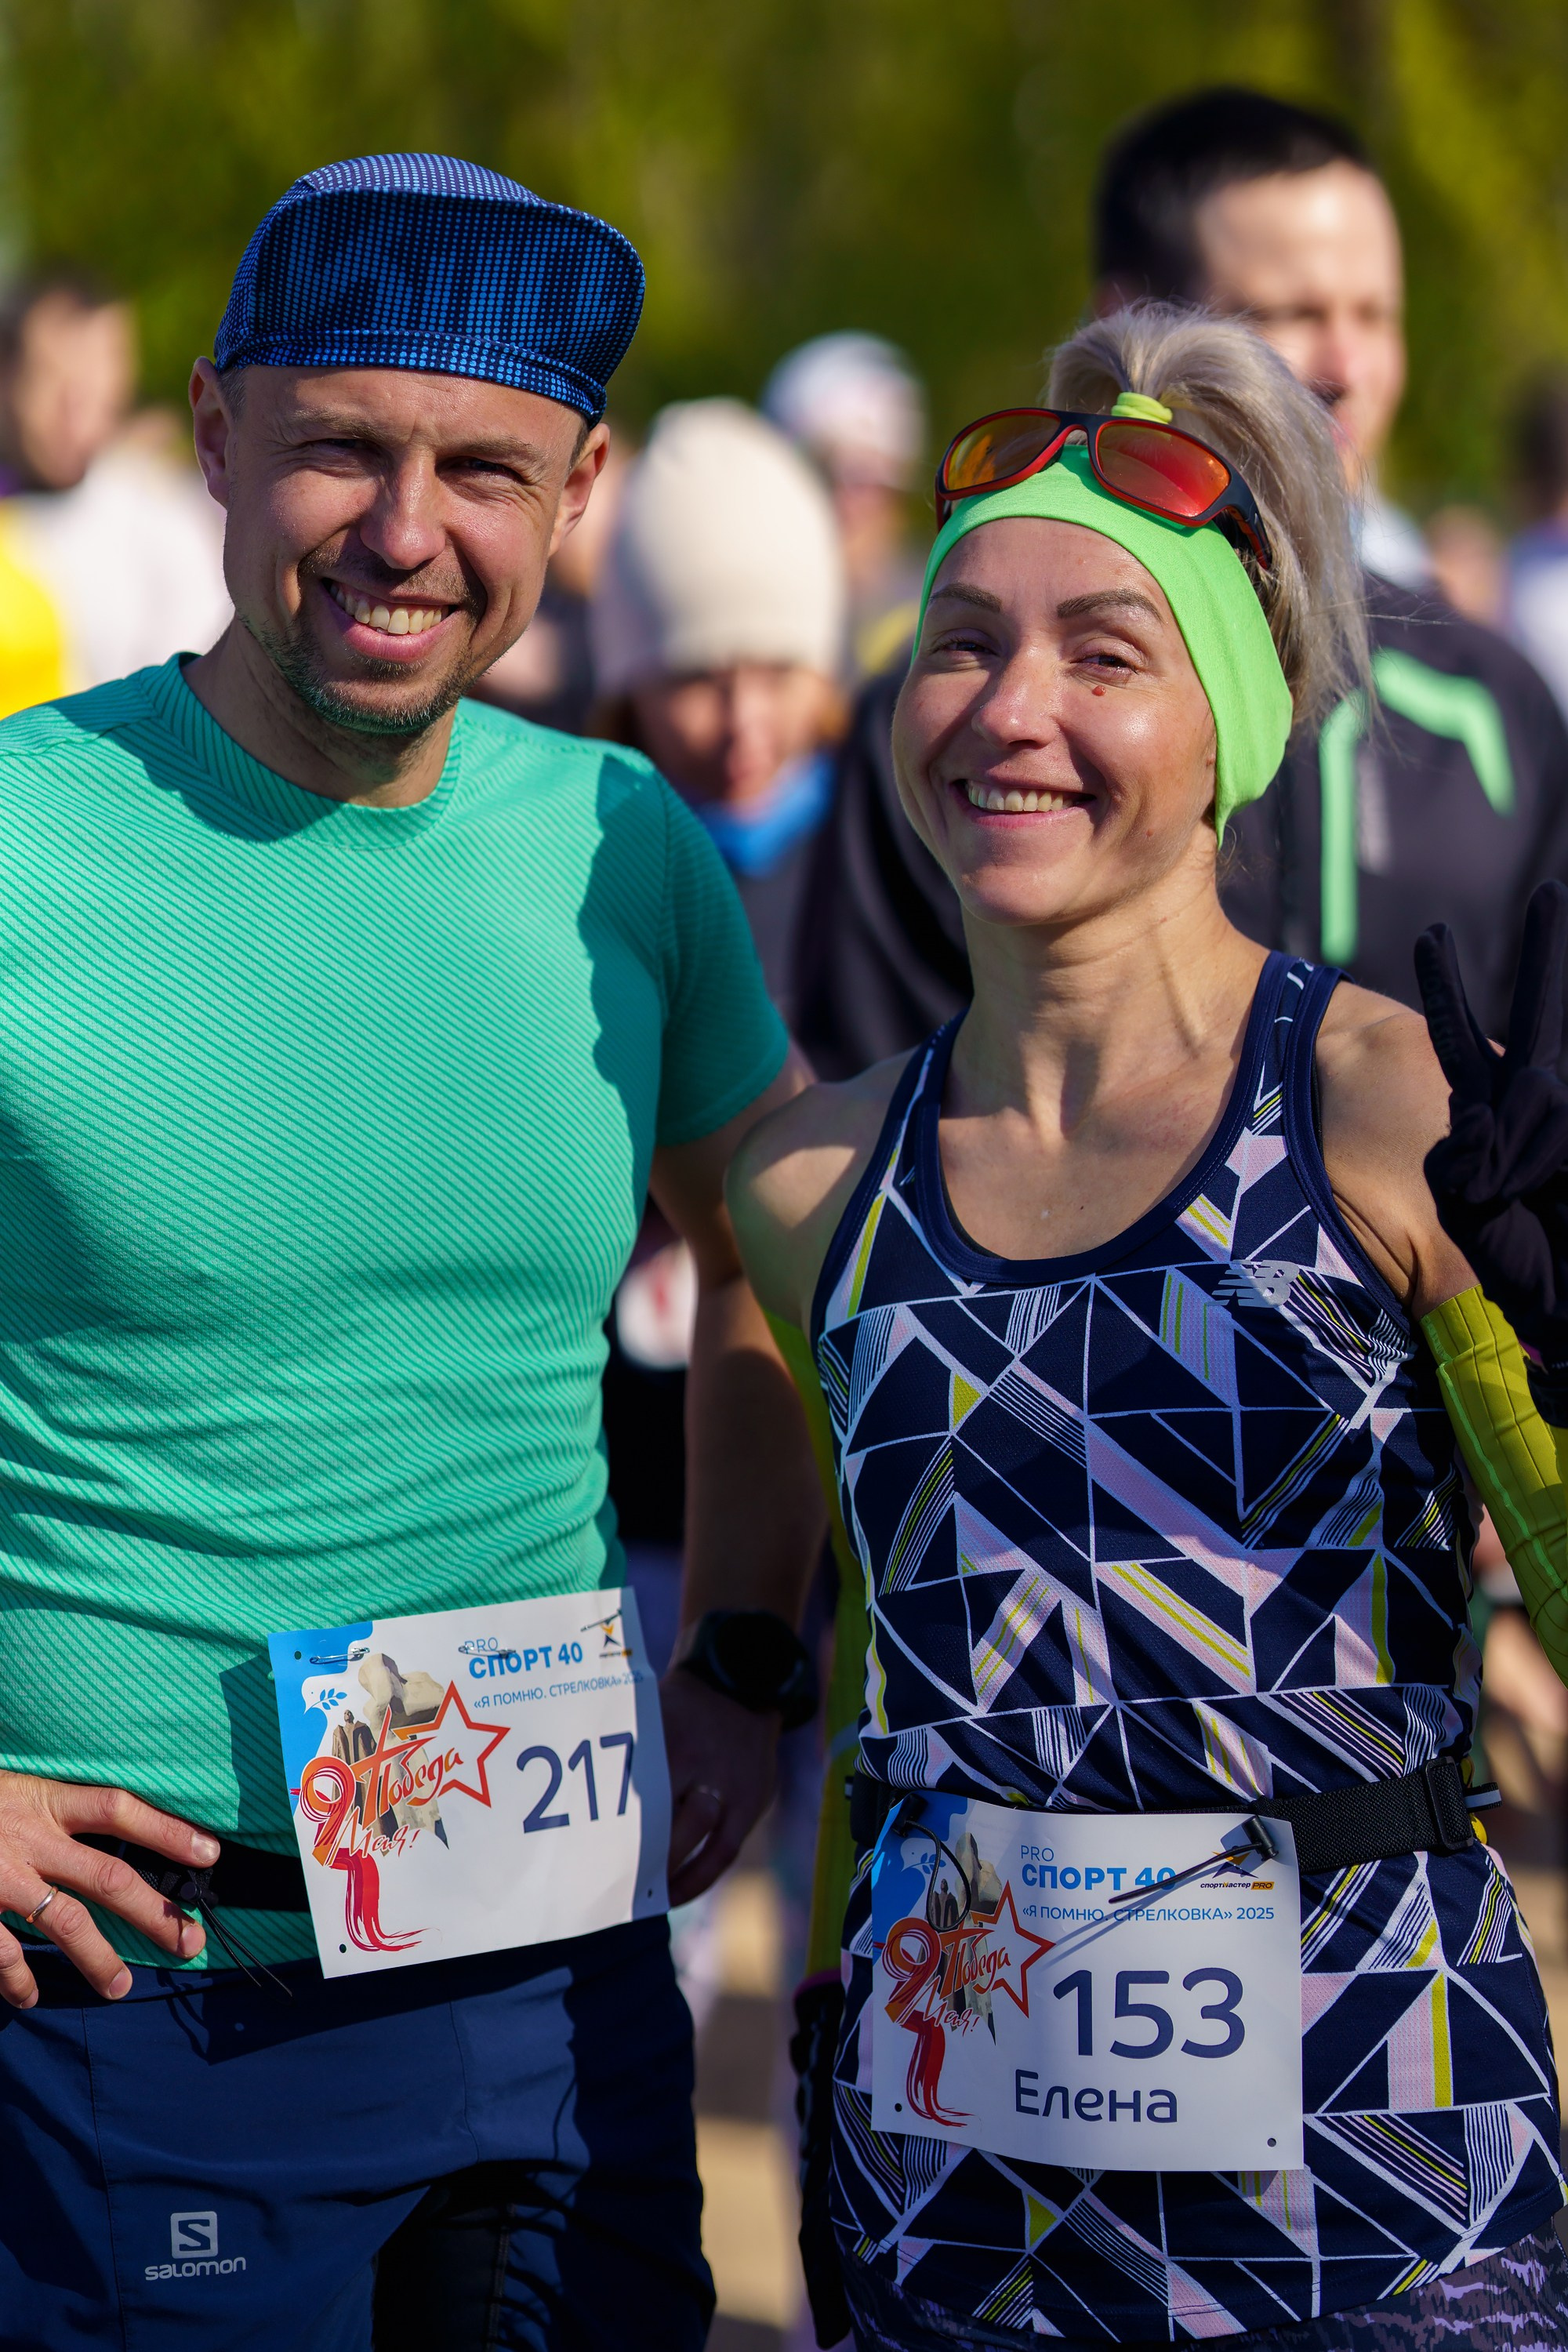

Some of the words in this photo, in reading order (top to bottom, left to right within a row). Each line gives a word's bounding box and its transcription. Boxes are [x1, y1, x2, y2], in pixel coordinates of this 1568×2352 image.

[468, 1645, 553, 1679] СПОРТ
[557, 1641, 583, 1665] 40
[516, 1731, 634, 1835] 217
[1021, 1845, 1054, 1862] PRO
[1022, 1864, 1127, 1890] СПОРТ
[1134, 1867, 1177, 1890] 40
[1022, 1904, 1037, 1918] «Я
[1040, 1906, 1109, 1922] ПОМНЮ.
[1113, 1907, 1232, 1922] СТРЕЛКОВКА»
[1236, 1907, 1275, 1920] 2025
[1052, 1966, 1246, 2060] 153
[1014, 2068, 1178, 2123] Елена
